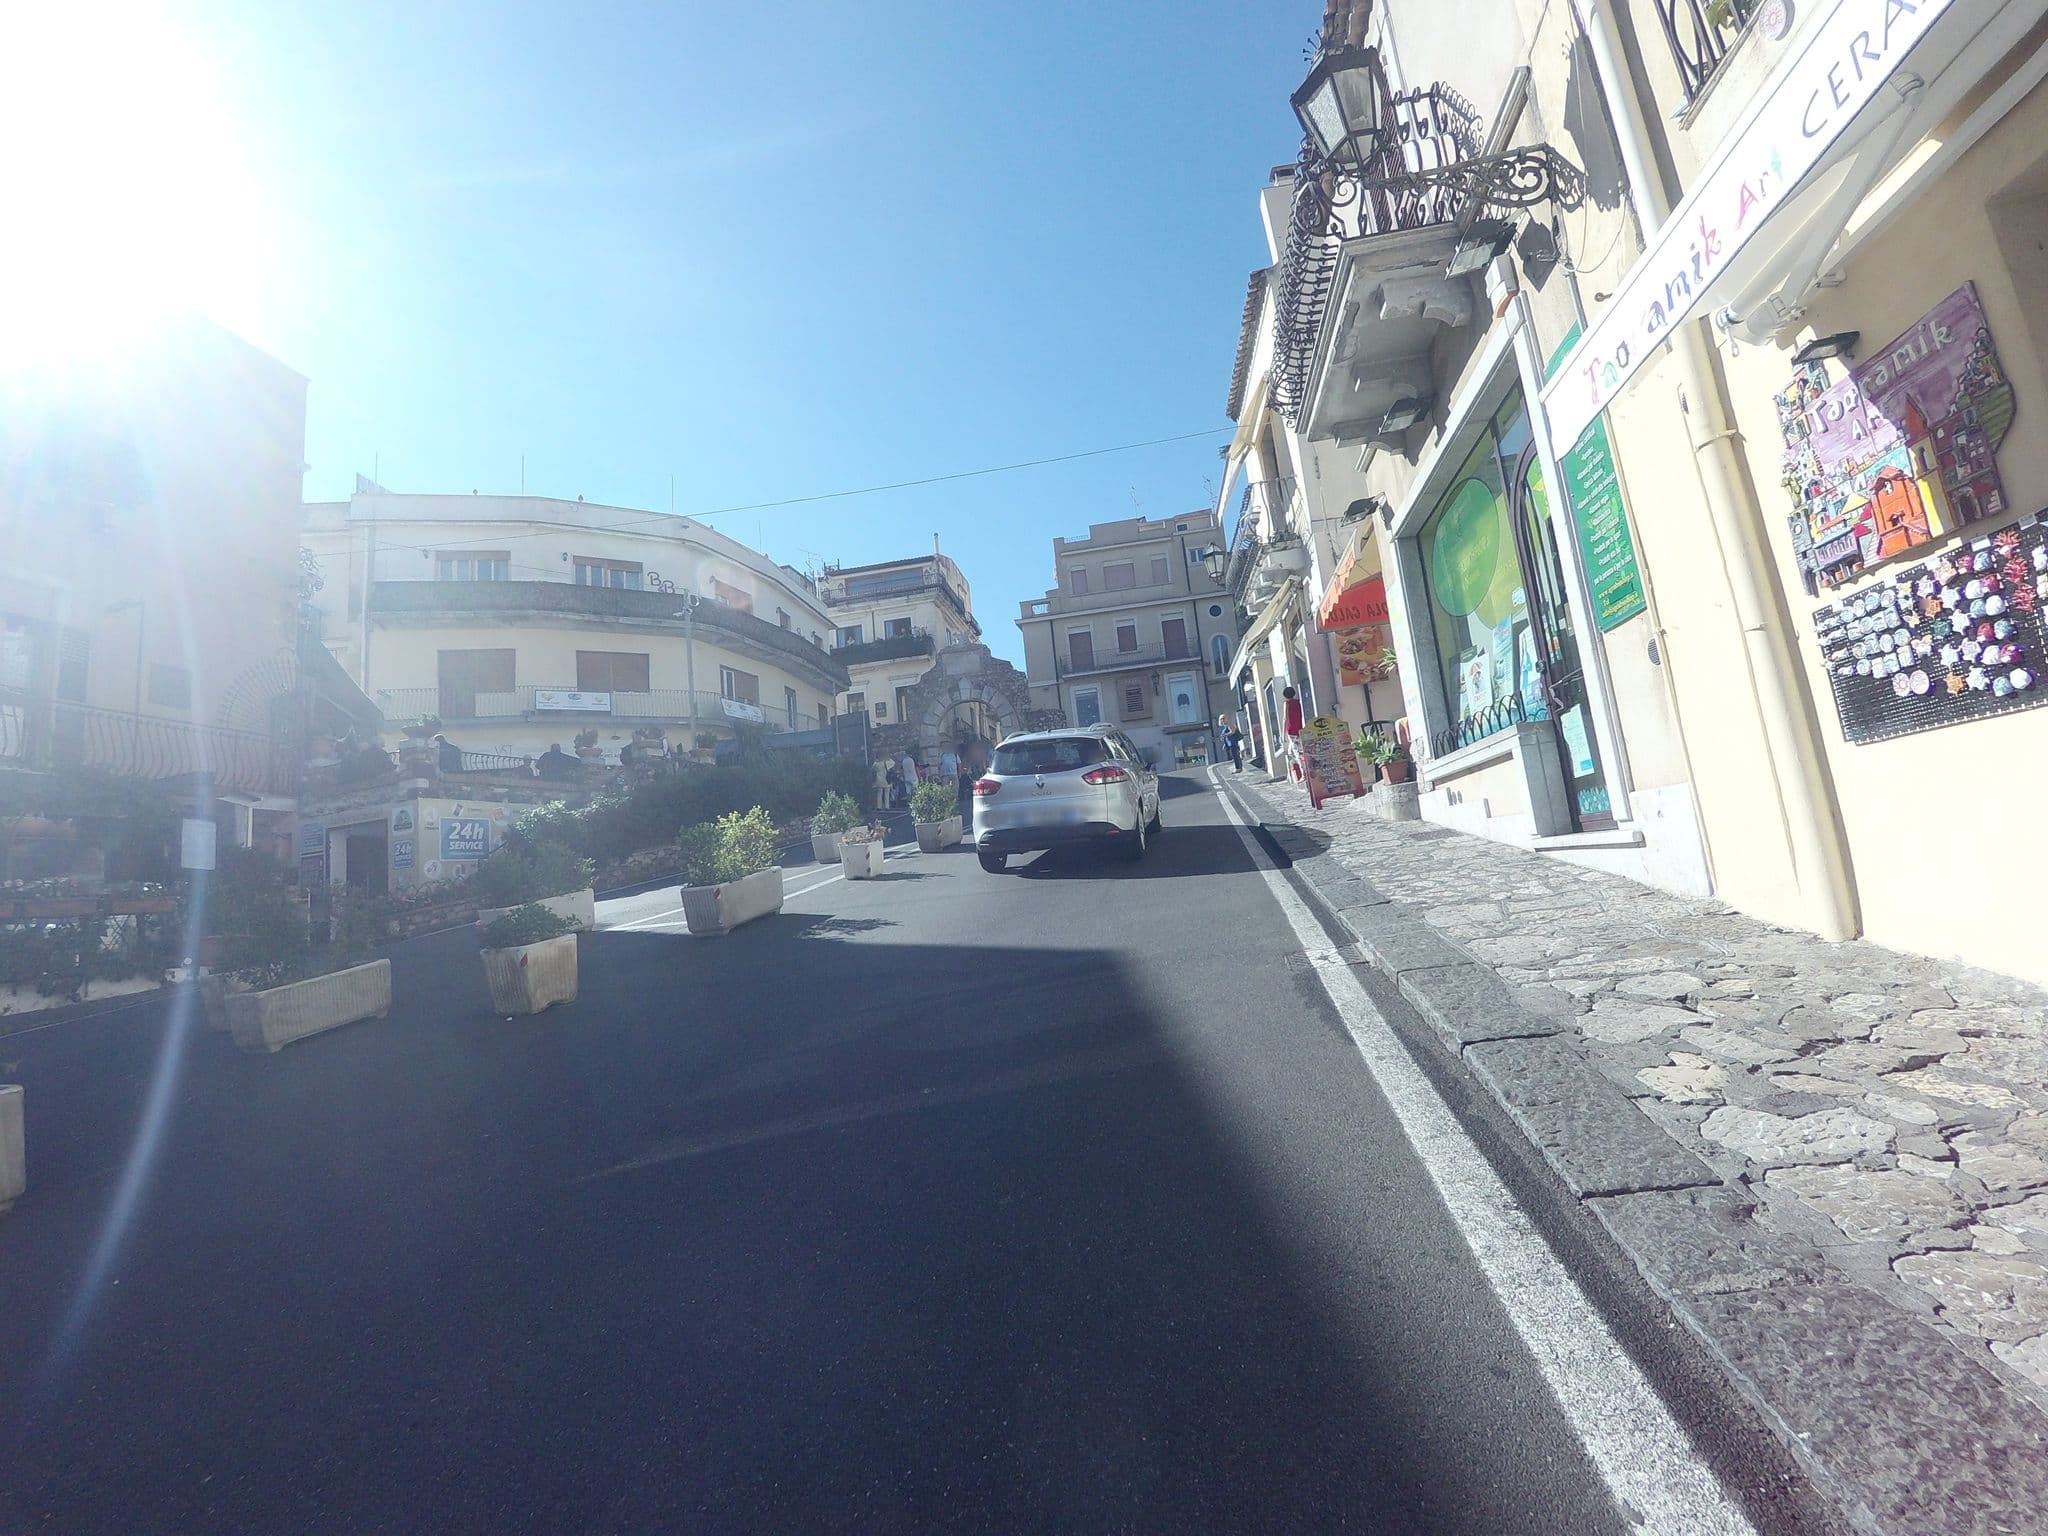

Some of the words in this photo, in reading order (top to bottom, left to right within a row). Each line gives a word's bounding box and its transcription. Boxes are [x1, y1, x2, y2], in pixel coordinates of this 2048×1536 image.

[1802, 0, 1917, 138] CERA
[449, 822, 484, 840] 24h
[449, 841, 484, 850] SERVICE
